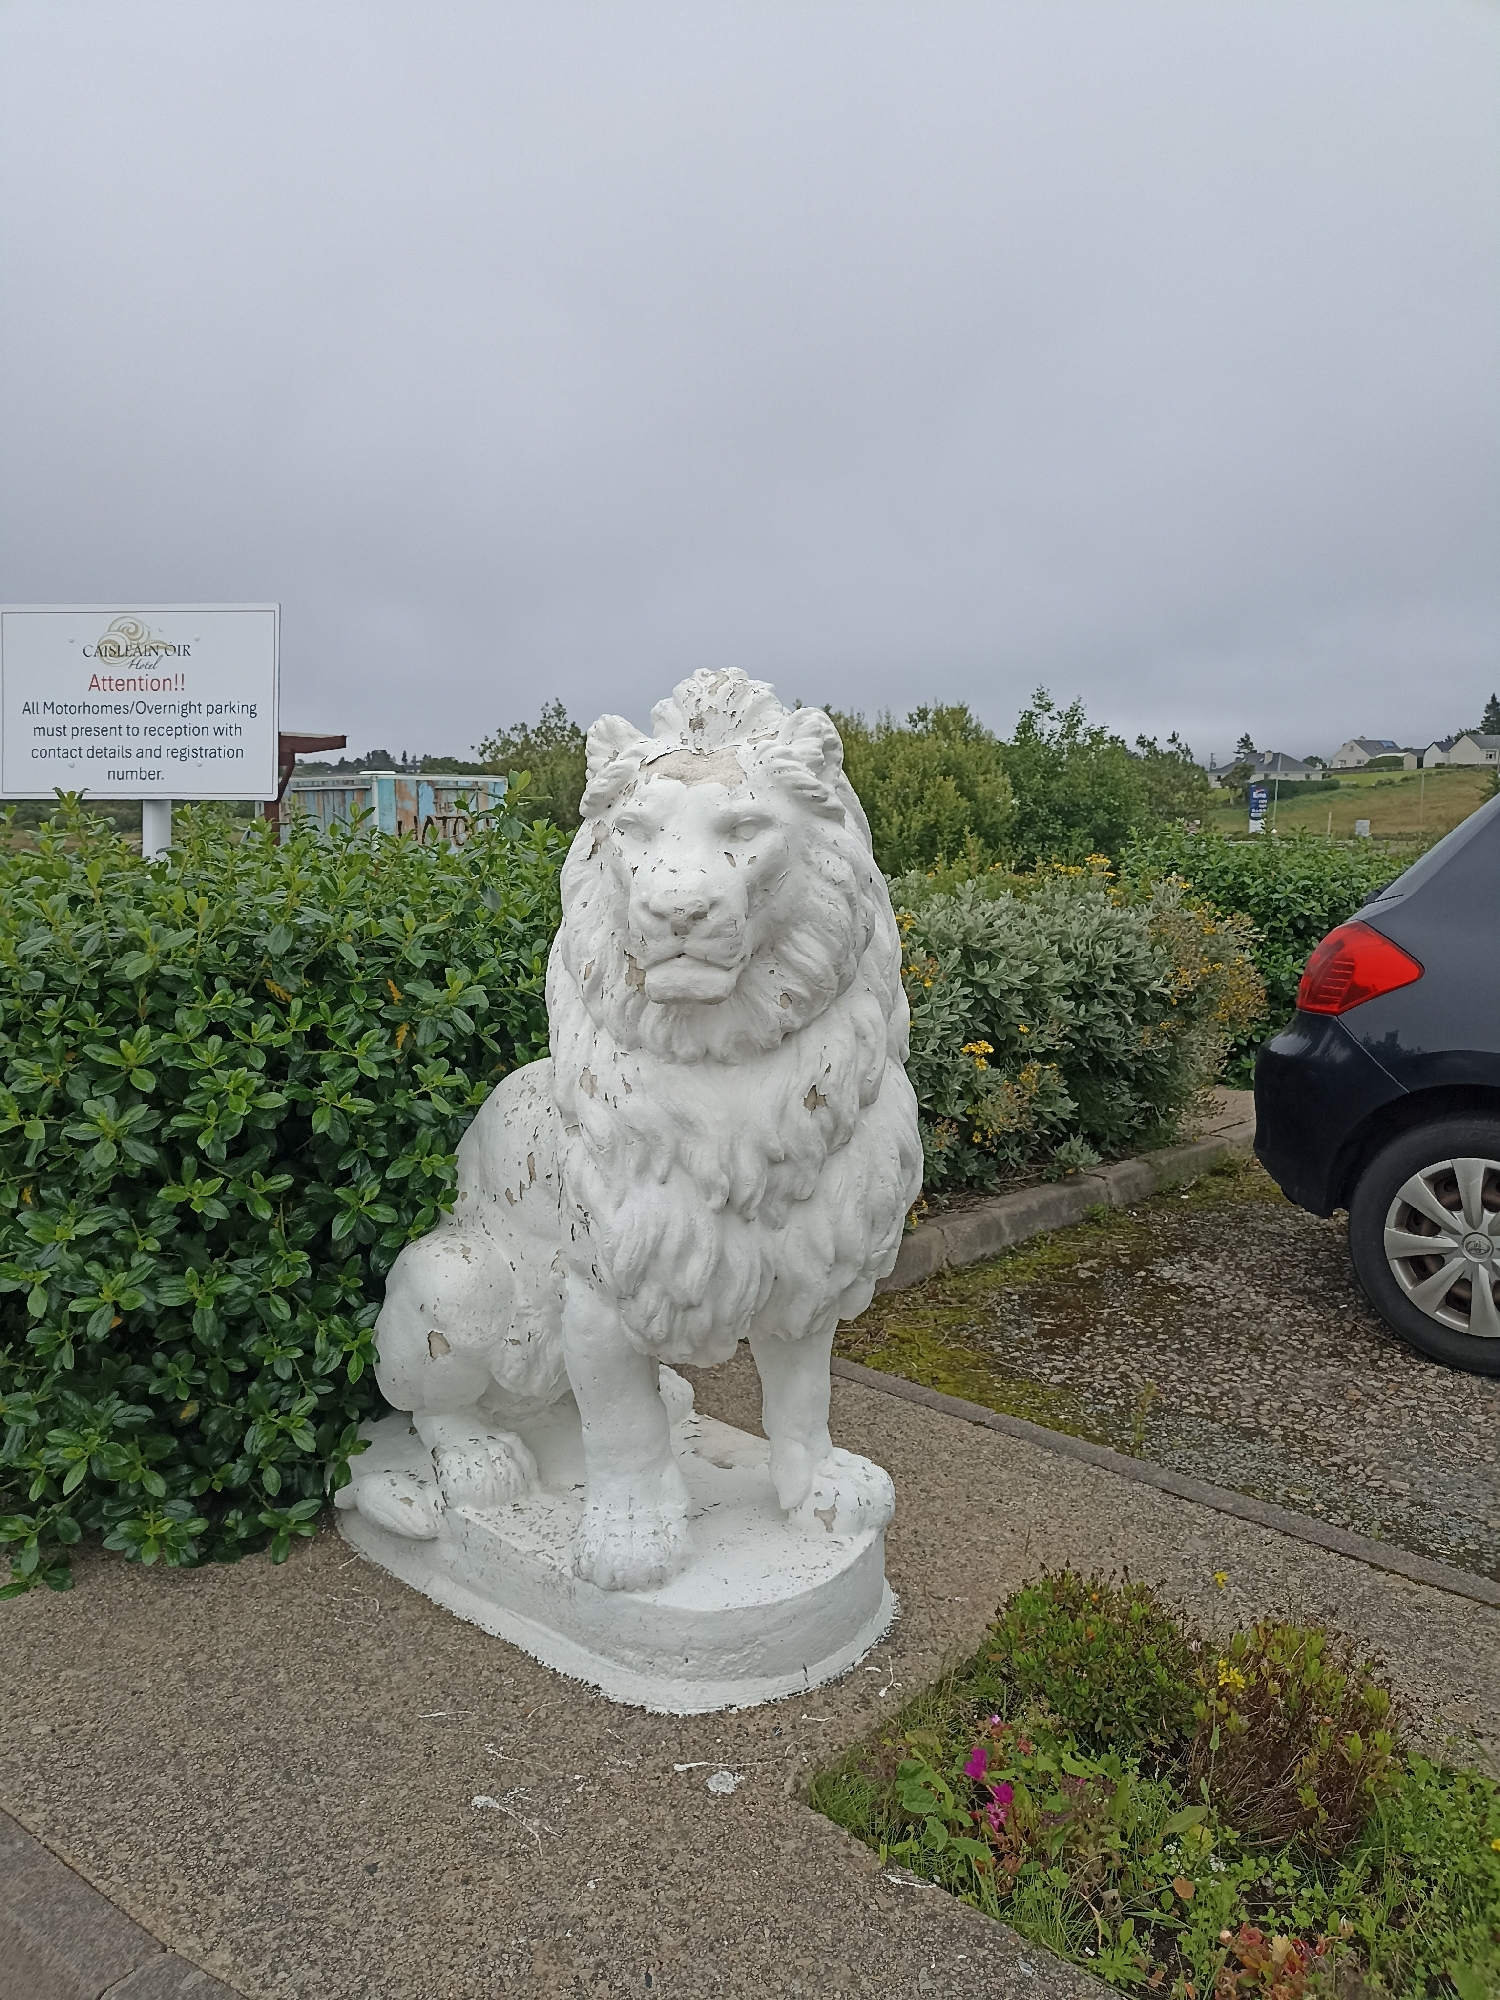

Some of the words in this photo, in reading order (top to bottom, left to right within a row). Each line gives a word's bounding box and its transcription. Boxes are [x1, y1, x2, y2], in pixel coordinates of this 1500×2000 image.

[128, 655, 164, 670] Hotel
[87, 673, 185, 692] Attention!!
[22, 702, 40, 716] All
[42, 701, 203, 718] Motorhomes/Overnight
[206, 702, 258, 719] parking
[33, 725, 68, 738] must
[70, 725, 124, 741] present
[125, 725, 140, 738] to
[143, 723, 209, 740] reception
[212, 723, 242, 738] with
[31, 747, 84, 760] contact
[86, 746, 132, 760] details
[135, 746, 162, 760] and
[165, 745, 244, 763] registration
[107, 767, 165, 781] number.
